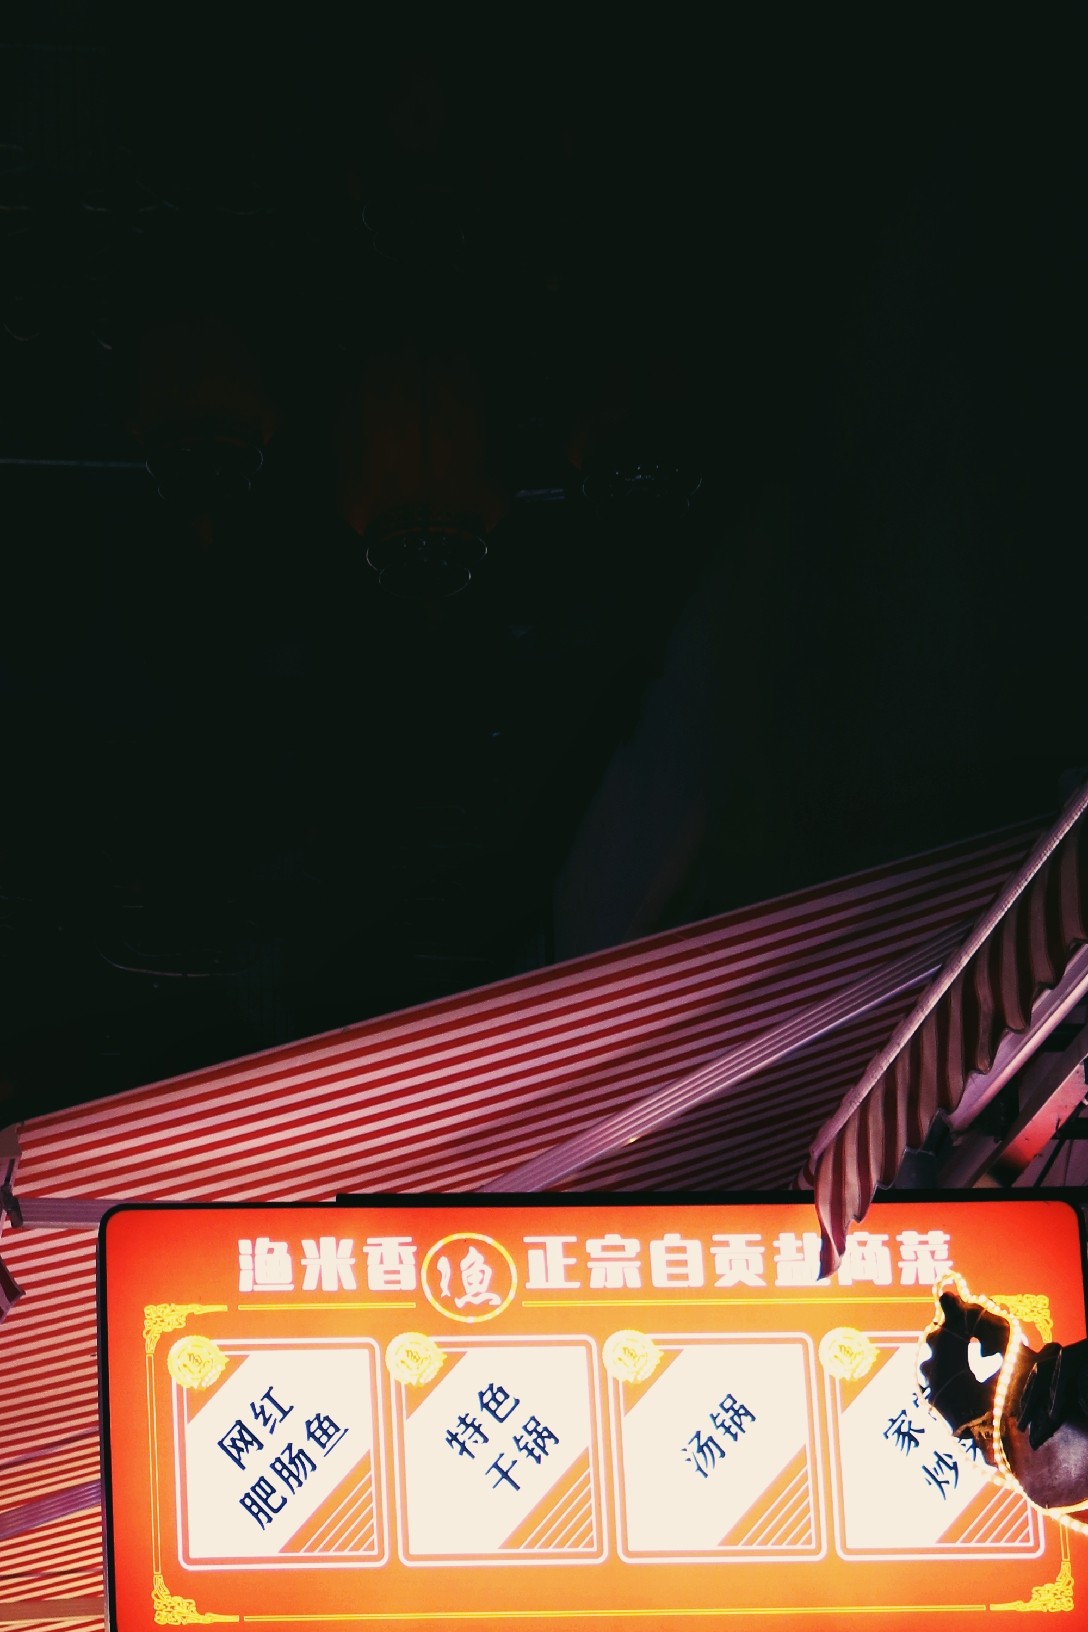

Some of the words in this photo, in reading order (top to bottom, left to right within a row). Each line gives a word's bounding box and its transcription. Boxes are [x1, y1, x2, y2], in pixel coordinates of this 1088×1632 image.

[238, 1237, 416, 1292] 渔米香
[523, 1231, 954, 1290] 正宗自贡盐商菜
[218, 1386, 294, 1470] 网红
[445, 1382, 520, 1459] 特色
[485, 1414, 561, 1491] 干锅
[681, 1393, 756, 1478] 汤锅
[239, 1412, 349, 1530] 肥肠鱼
